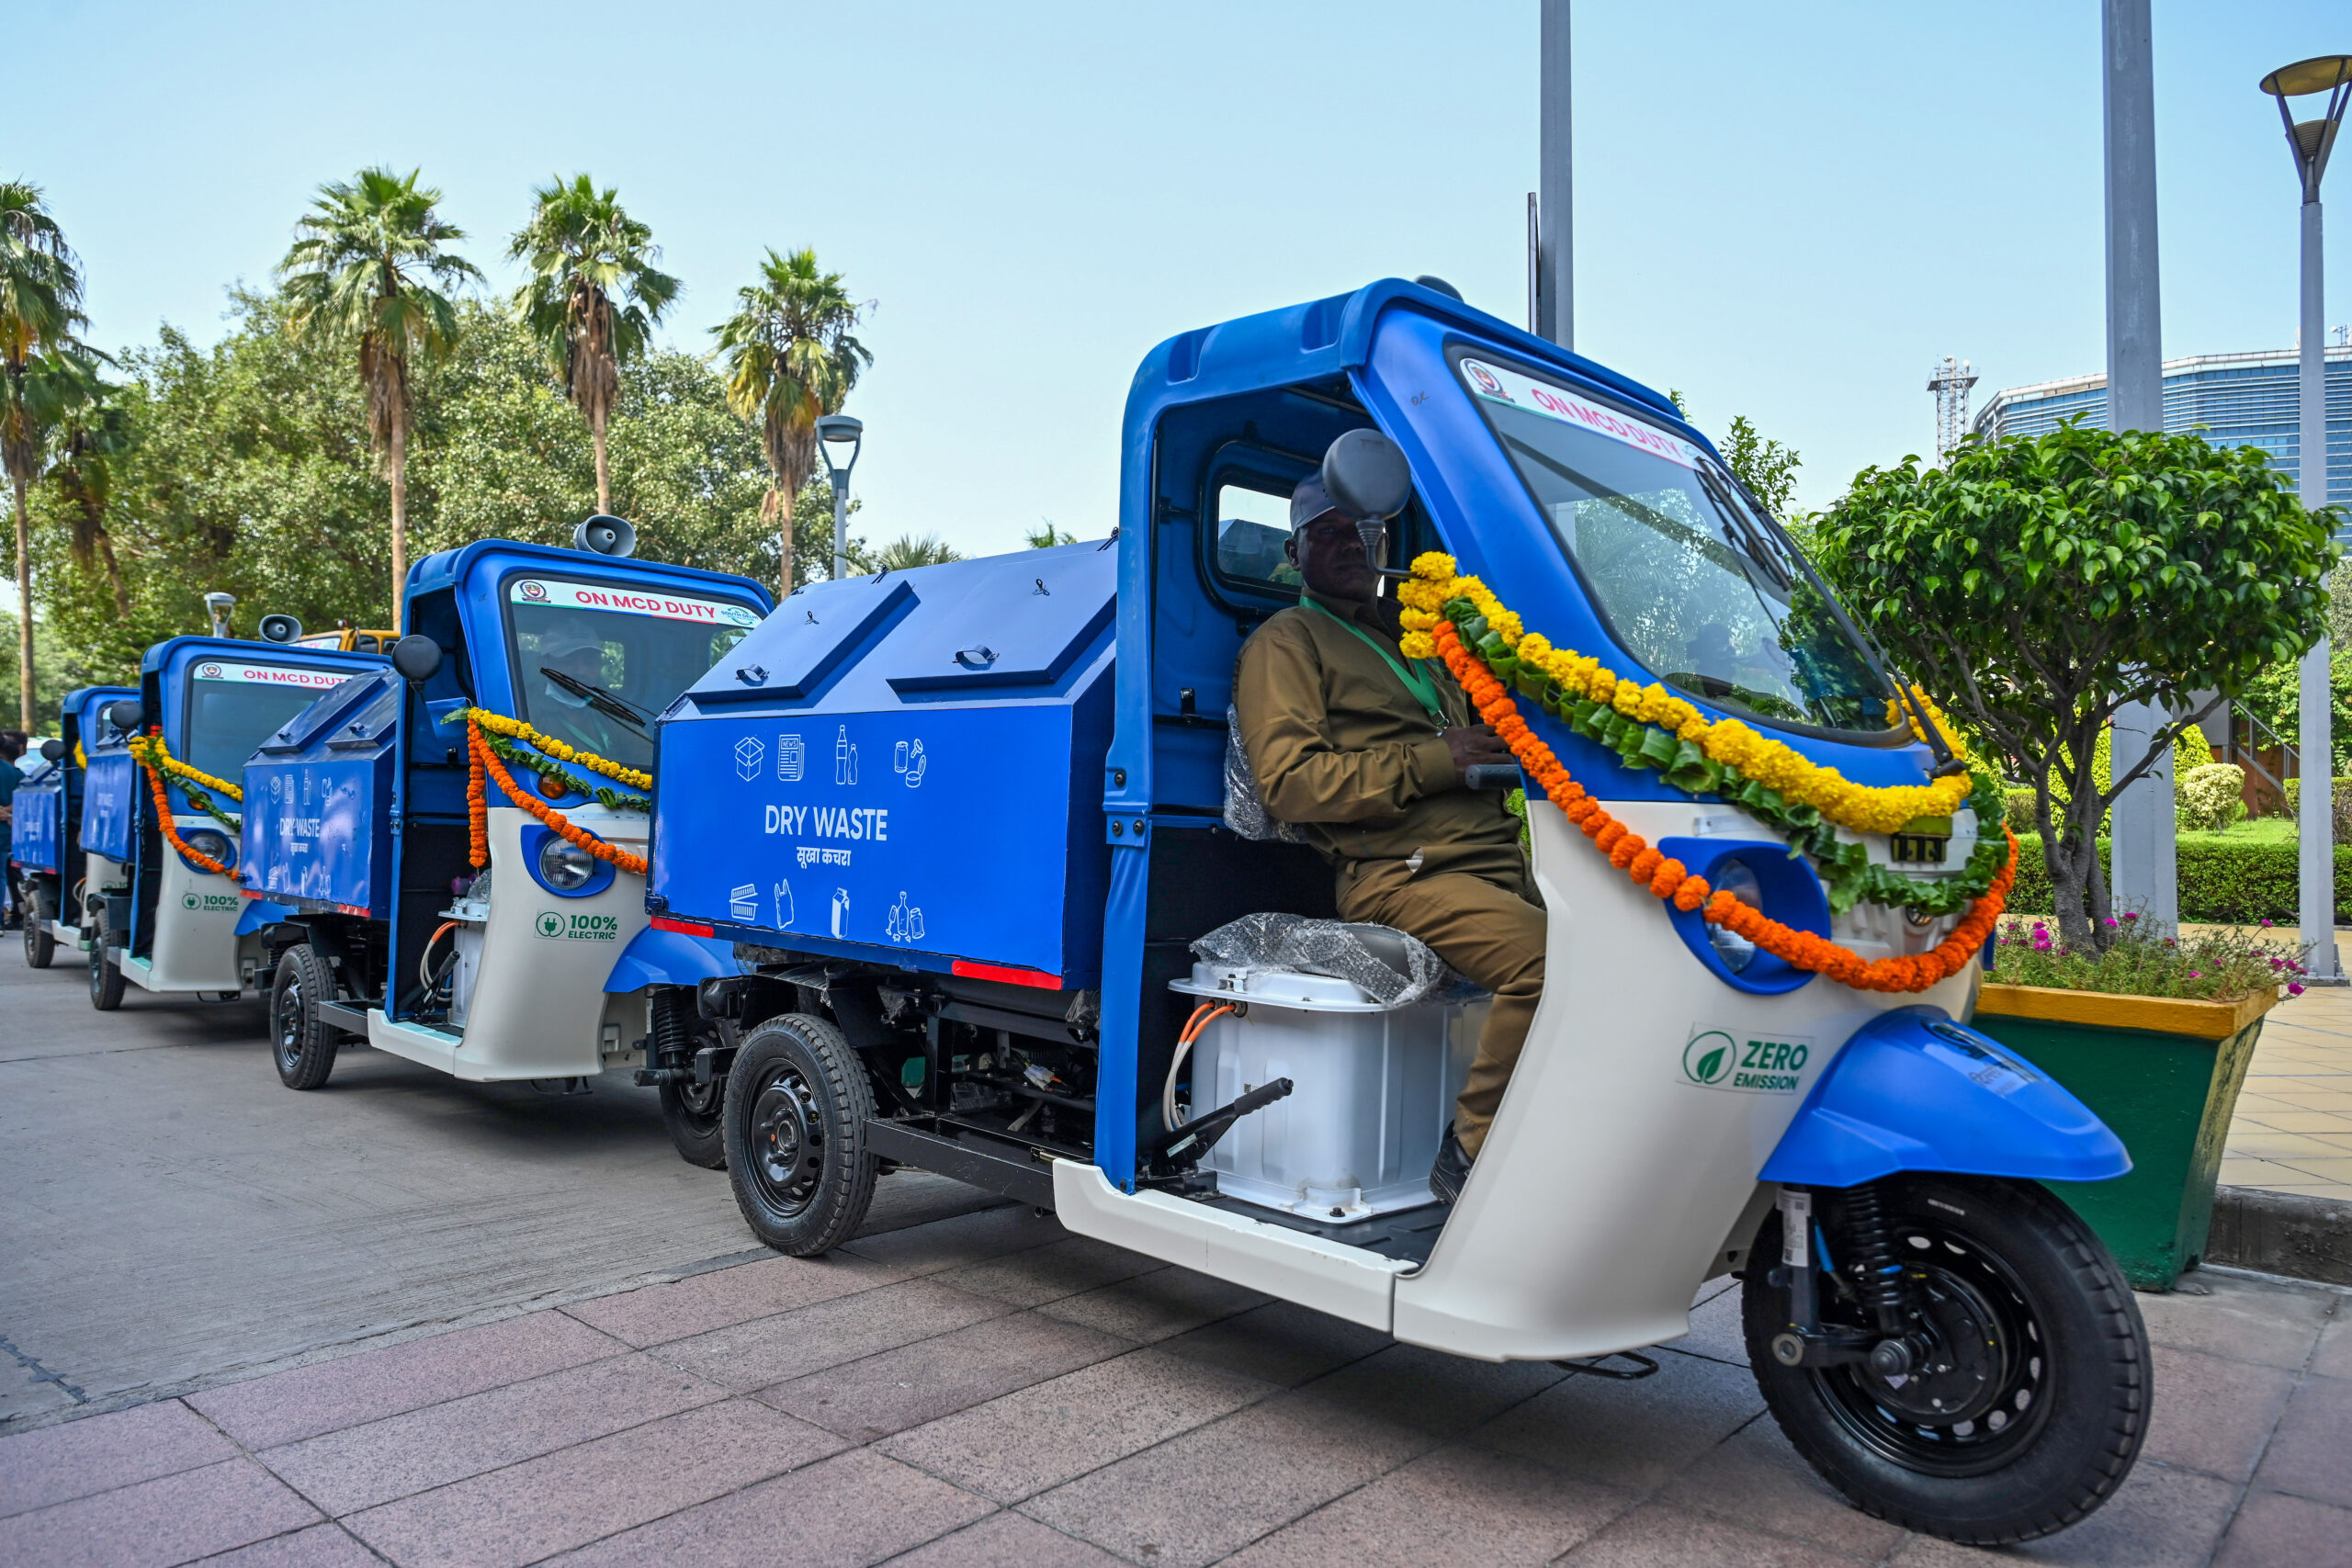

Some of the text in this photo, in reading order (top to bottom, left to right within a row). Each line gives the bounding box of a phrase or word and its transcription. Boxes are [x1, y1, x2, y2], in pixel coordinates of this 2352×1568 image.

[1532, 389, 1576, 418] ON
[1569, 401, 1628, 437] MCD
[1624, 423, 1683, 459] DUTY
[575, 591, 716, 618] ON MCD DUTY
[243, 670, 346, 686] ON MCD DUT
[279, 818, 321, 838] DRY WASTE
[765, 805, 888, 841] DRY WASTE
[797, 846, 852, 869] सूखा कचरा
[204, 895, 239, 906] 100%
[571, 915, 617, 931] 100%
[568, 931, 616, 940] ELECTRIC
[1740, 1040, 1808, 1071] ZERO
[1733, 1072, 1799, 1090] EMISSION
